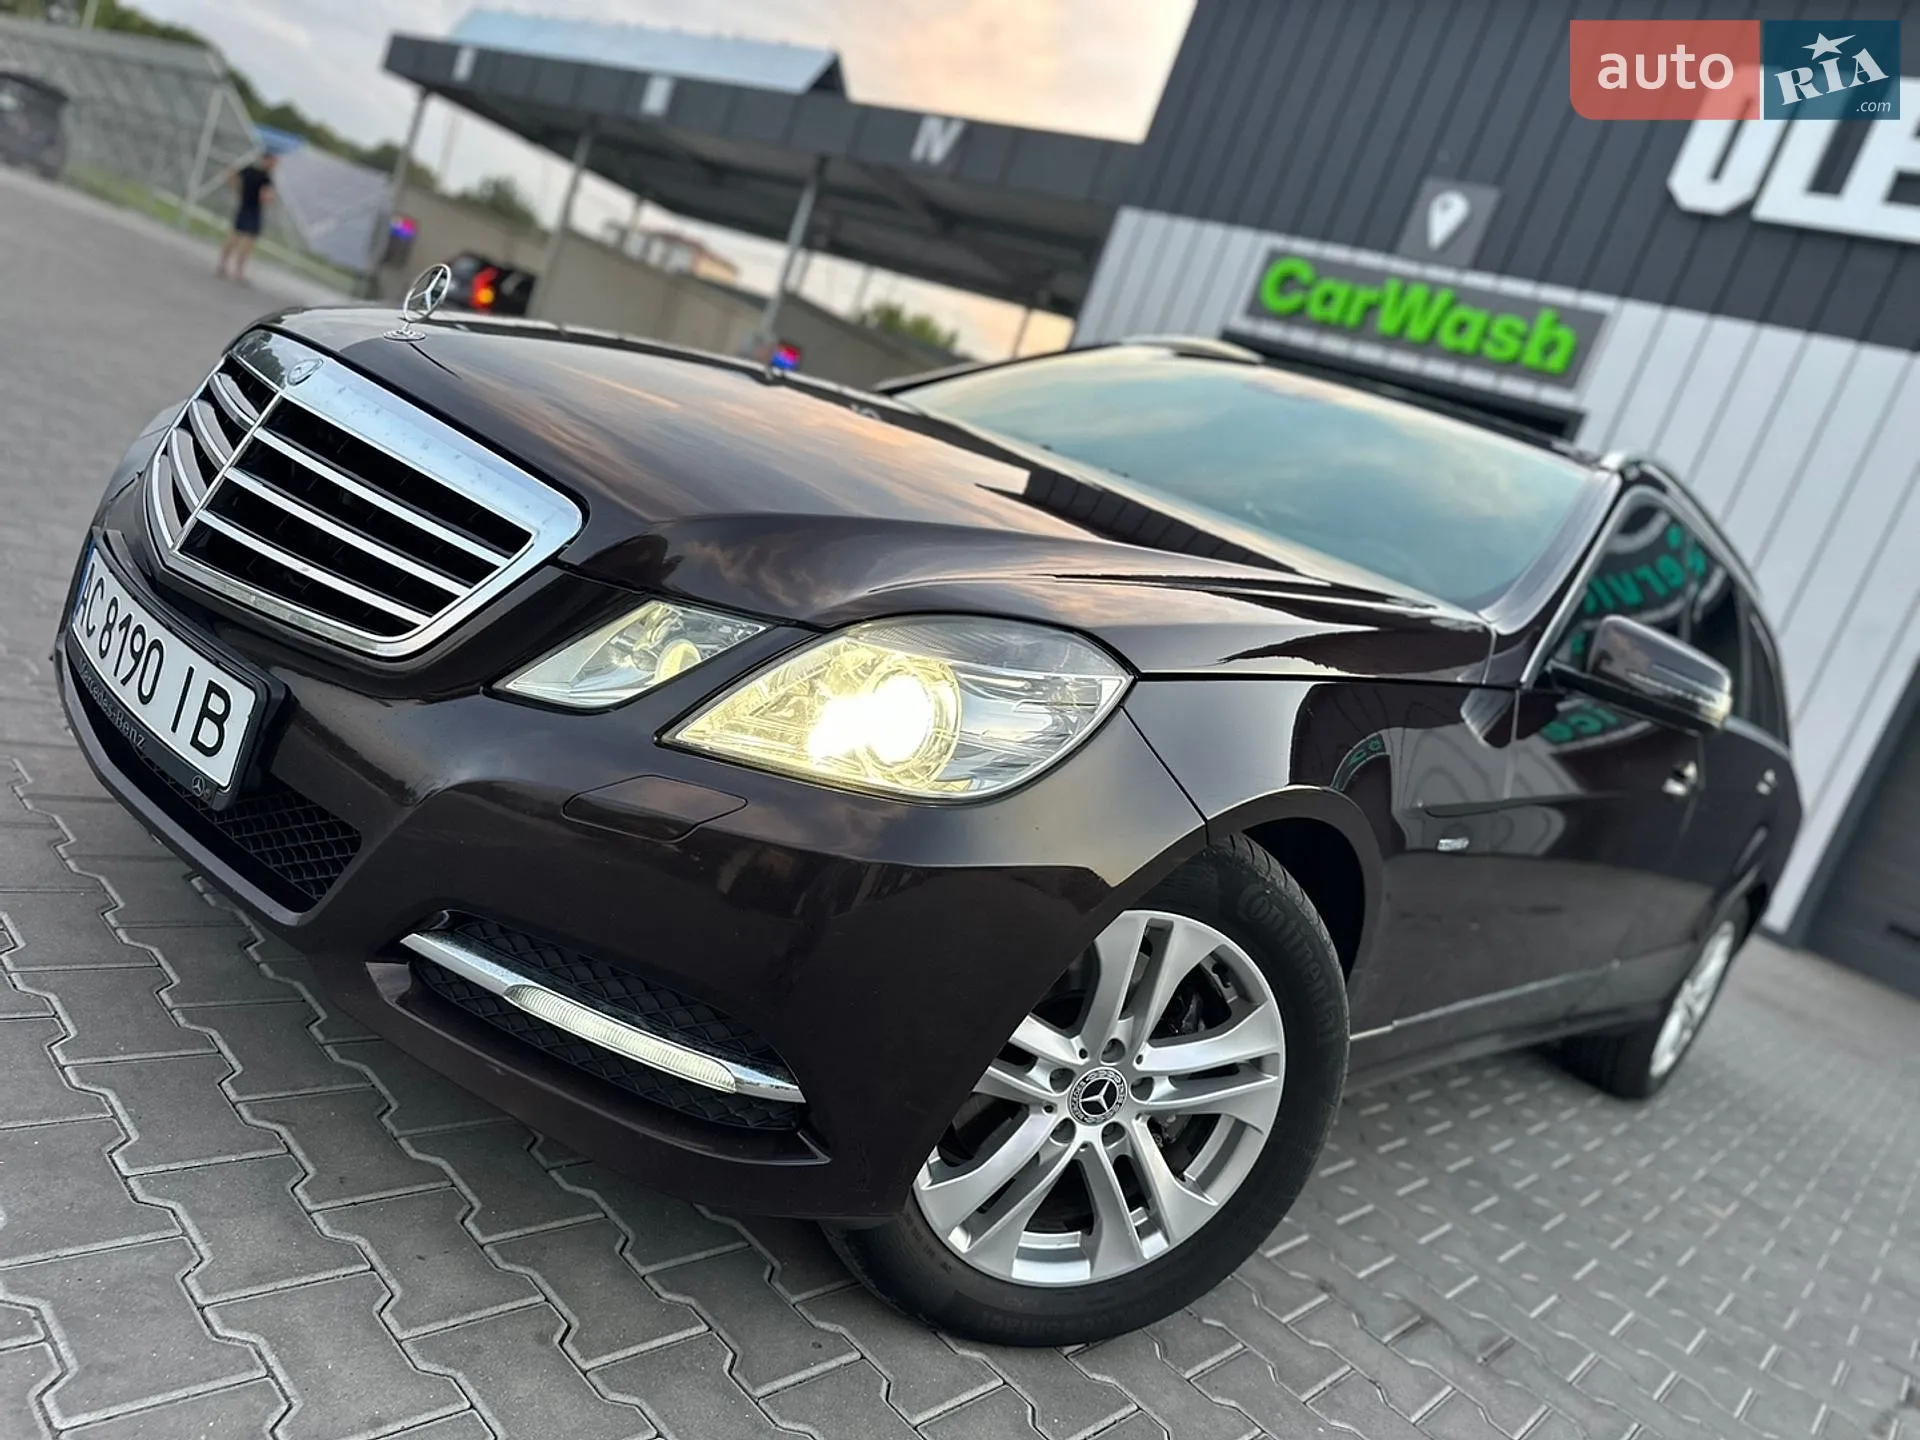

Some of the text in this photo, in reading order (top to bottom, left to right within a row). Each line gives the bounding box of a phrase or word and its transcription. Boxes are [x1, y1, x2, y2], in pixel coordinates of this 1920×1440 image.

[1259, 256, 1577, 375] CarWash
[79, 561, 232, 758] AC 8190 IB
[79, 656, 147, 750] Mercedes-Benz
[1237, 883, 1338, 1046] Continental
